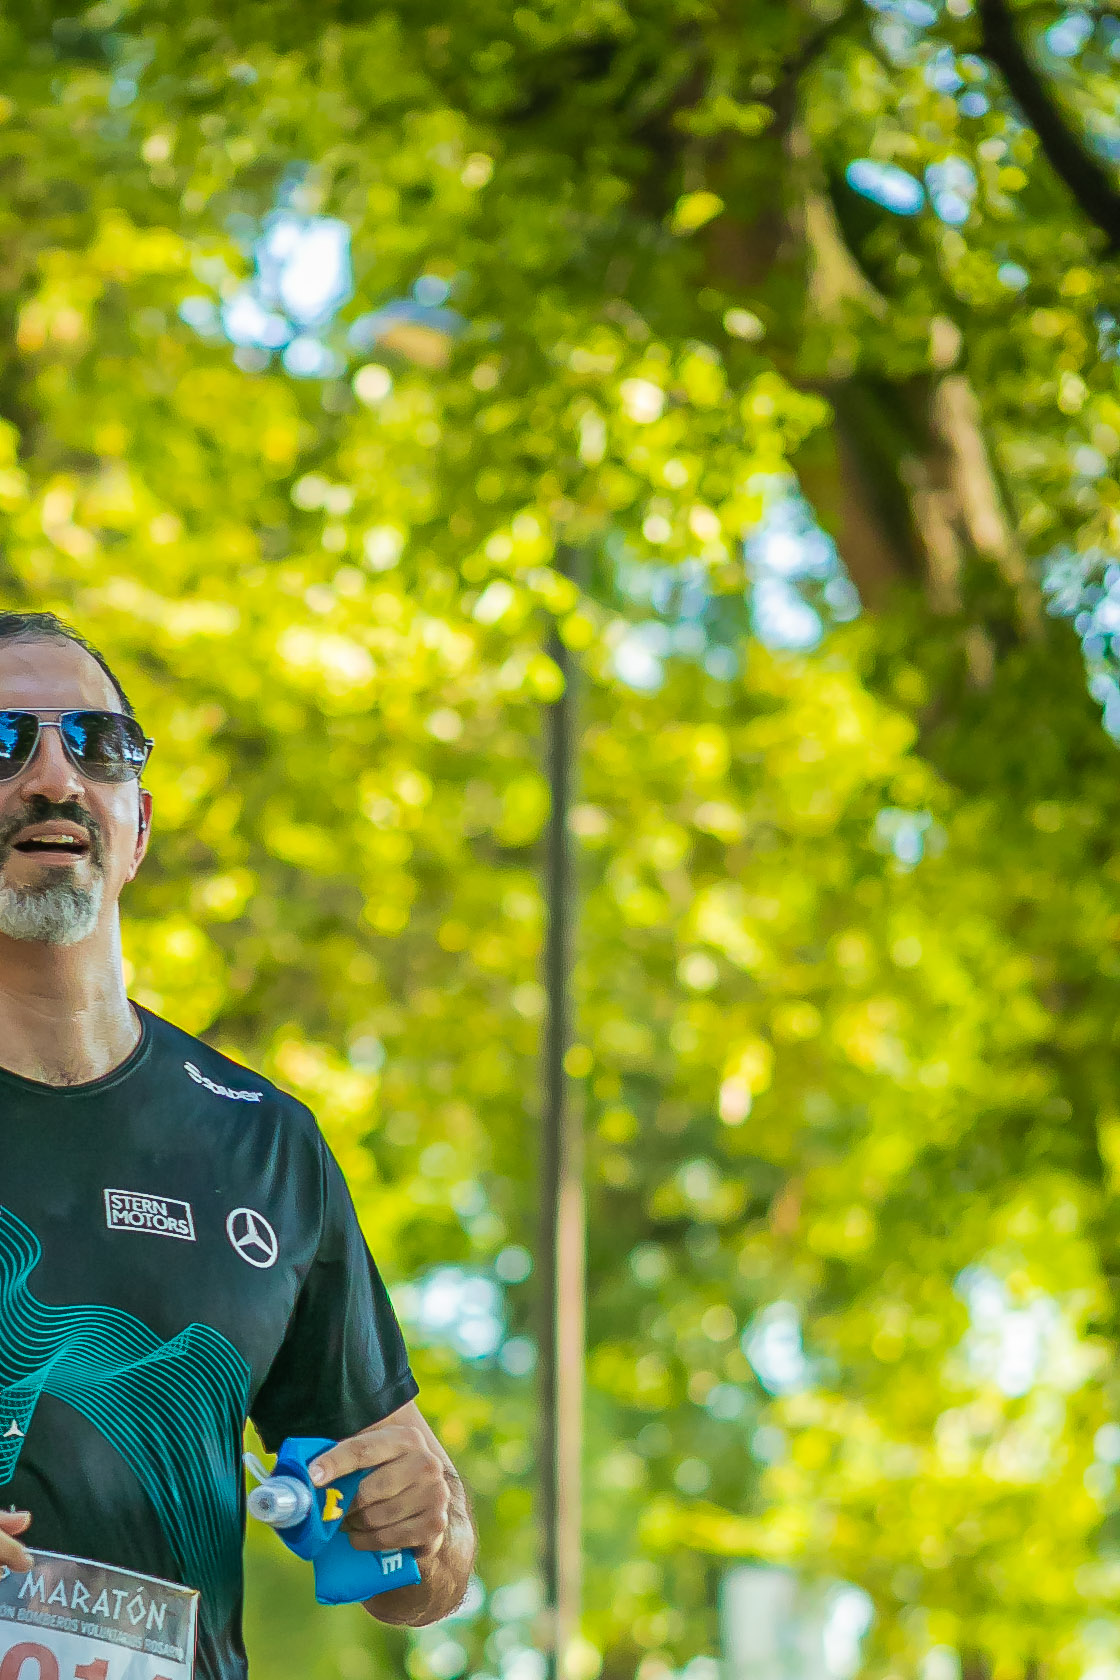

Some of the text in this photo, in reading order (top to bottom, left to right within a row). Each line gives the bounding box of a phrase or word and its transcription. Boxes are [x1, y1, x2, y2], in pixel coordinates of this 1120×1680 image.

[111, 1195, 168, 1216] STERN
[112, 1209, 190, 1235] MOTORS
[17, 1570, 168, 1631] MARATÓN
